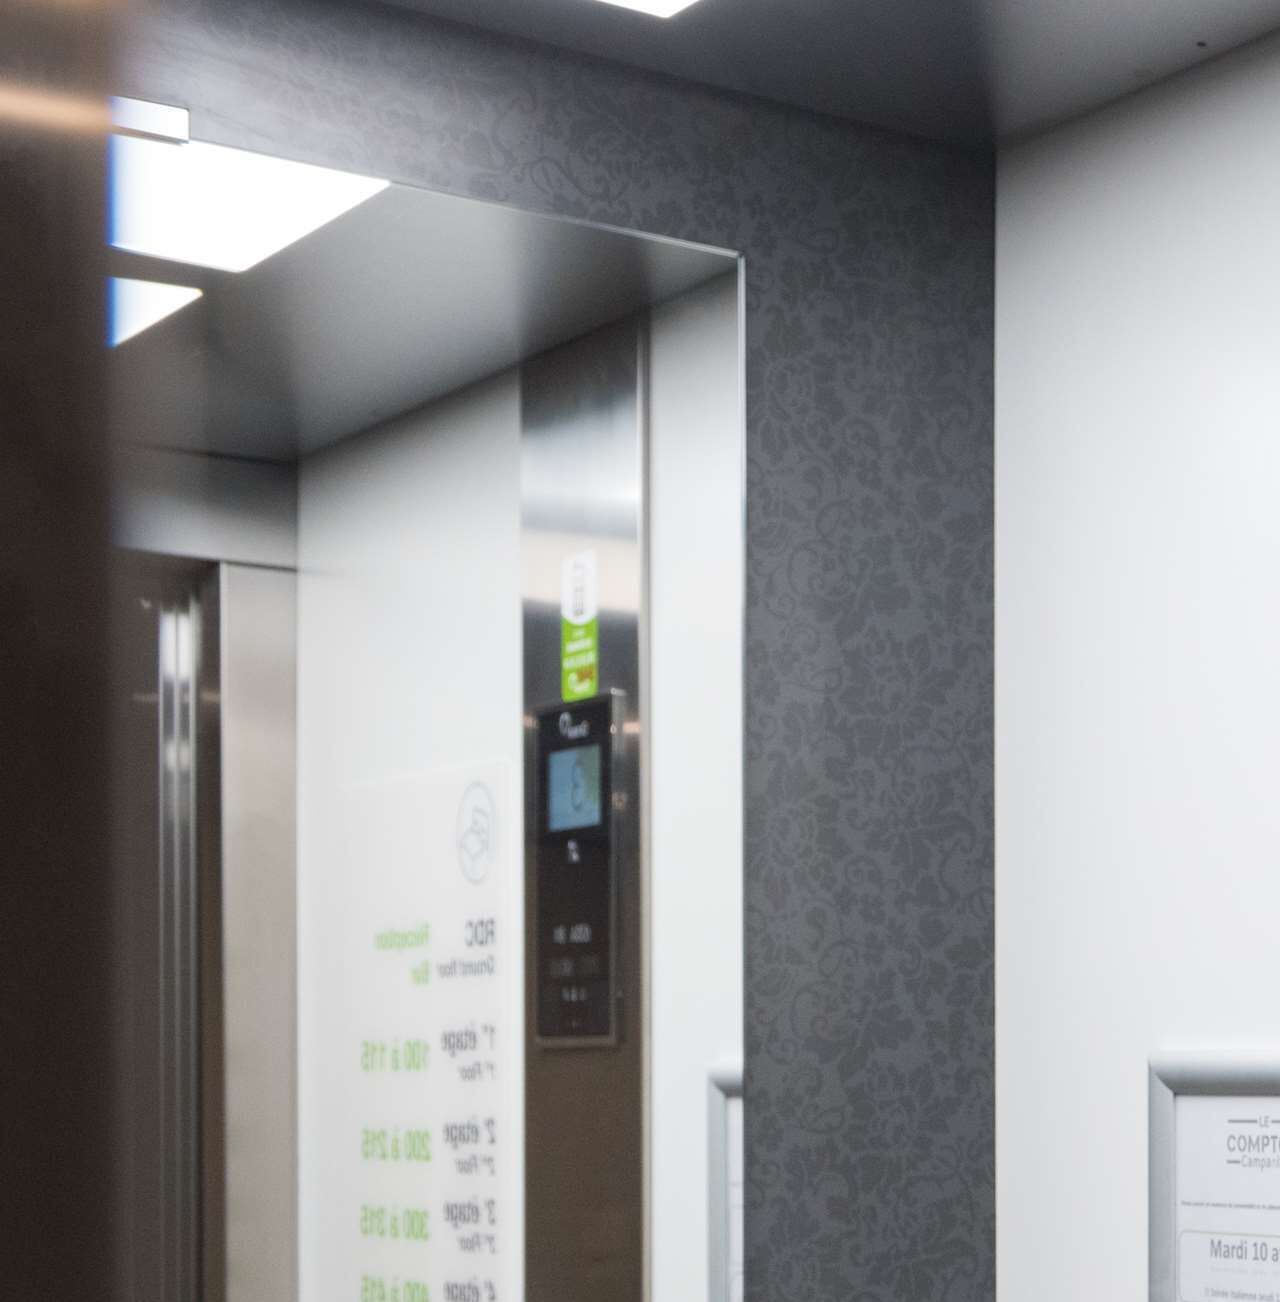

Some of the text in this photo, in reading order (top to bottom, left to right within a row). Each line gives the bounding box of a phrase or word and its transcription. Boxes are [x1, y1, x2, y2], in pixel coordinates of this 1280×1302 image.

[1259, 1115, 1269, 1128] LE
[1209, 1239, 1247, 1260] Mardi
[1252, 1242, 1268, 1261] 10
